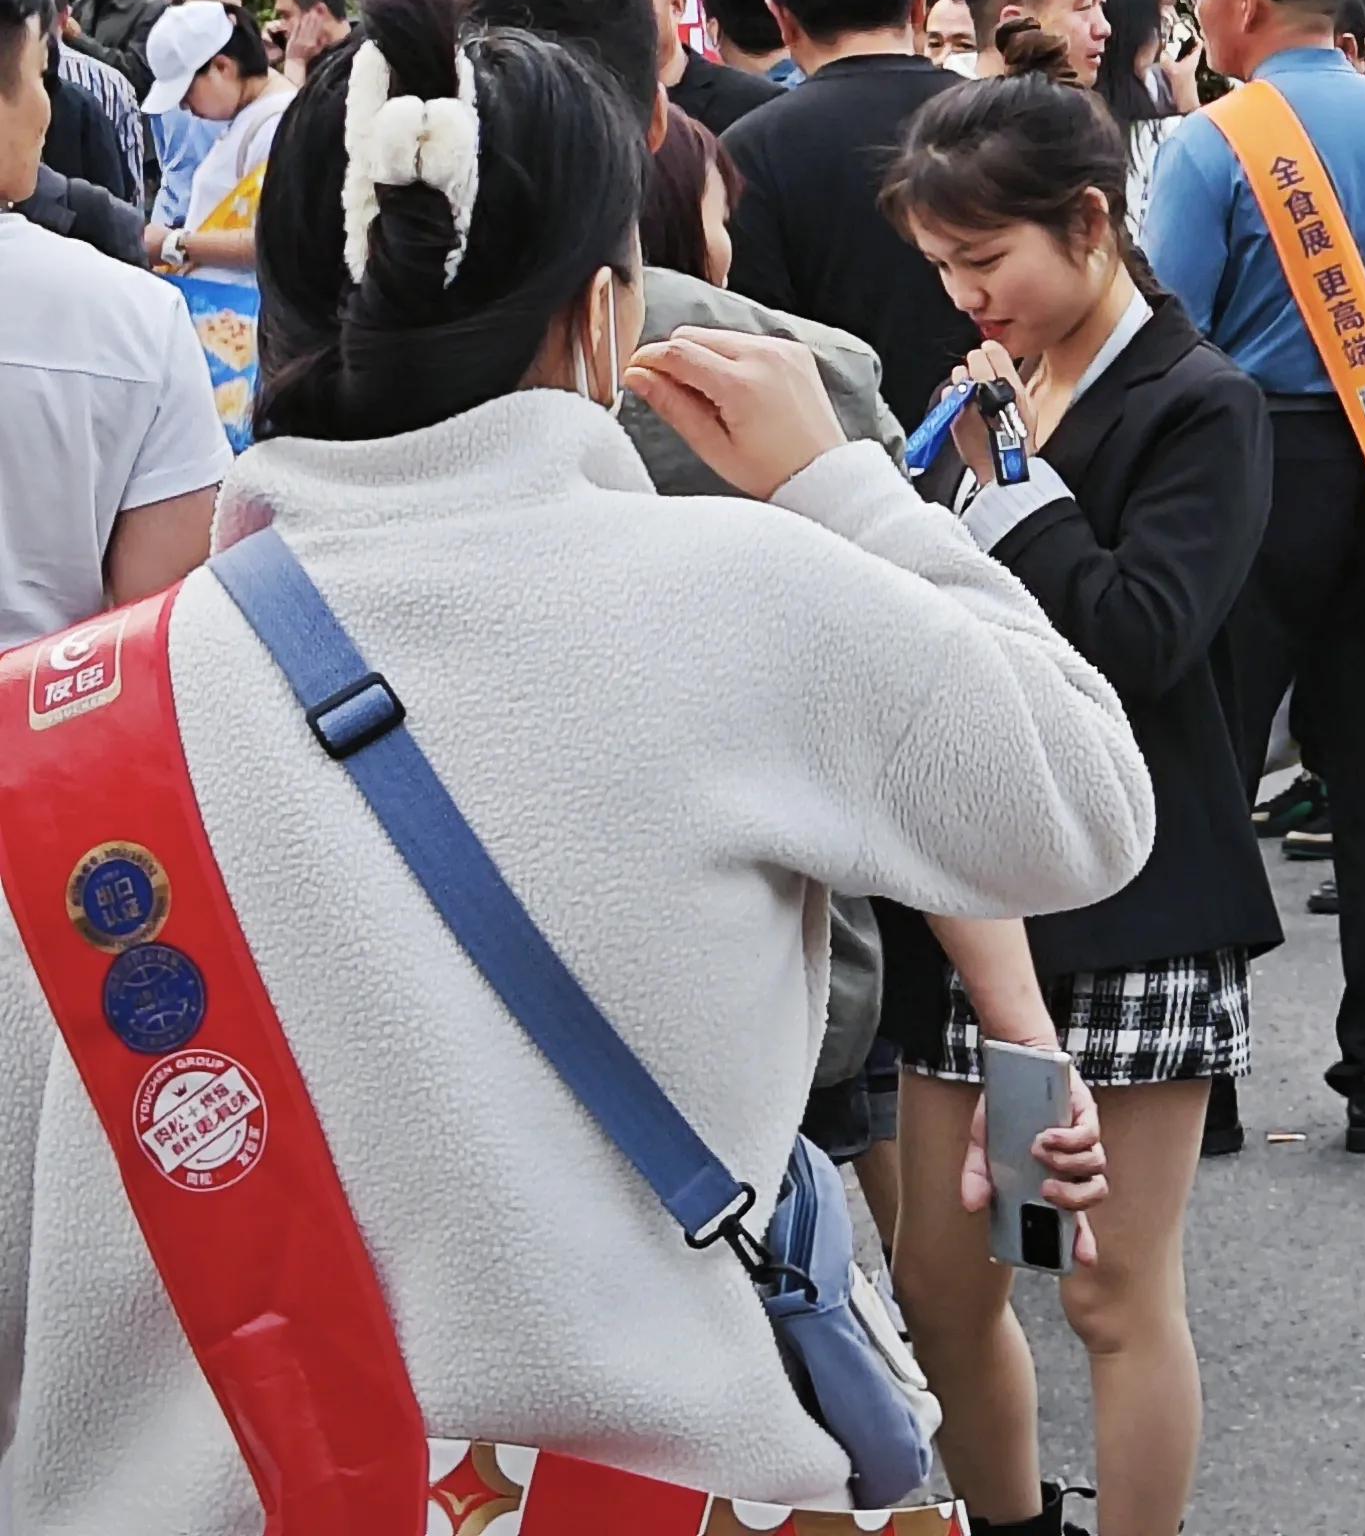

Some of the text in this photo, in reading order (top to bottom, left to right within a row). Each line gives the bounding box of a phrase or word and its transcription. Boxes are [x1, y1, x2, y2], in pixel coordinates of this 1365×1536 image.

[1269, 156, 1334, 259] 全食展
[44, 662, 104, 706] 友臣
[140, 1056, 225, 1124] YOUCHEN GROUP
